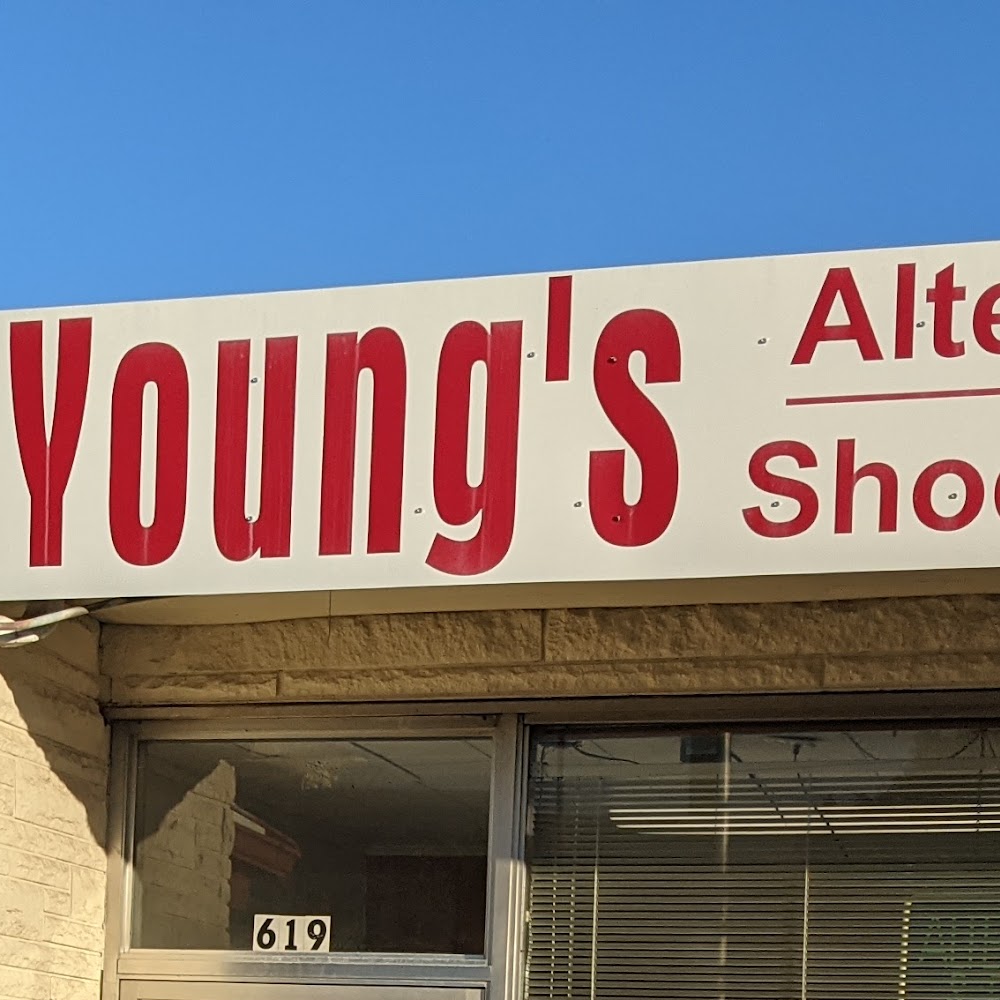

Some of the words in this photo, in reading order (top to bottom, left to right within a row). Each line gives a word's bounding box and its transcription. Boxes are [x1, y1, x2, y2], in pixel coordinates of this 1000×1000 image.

[10, 276, 681, 576] Young's
[742, 438, 1000, 538] Sho
[257, 918, 327, 950] 619
